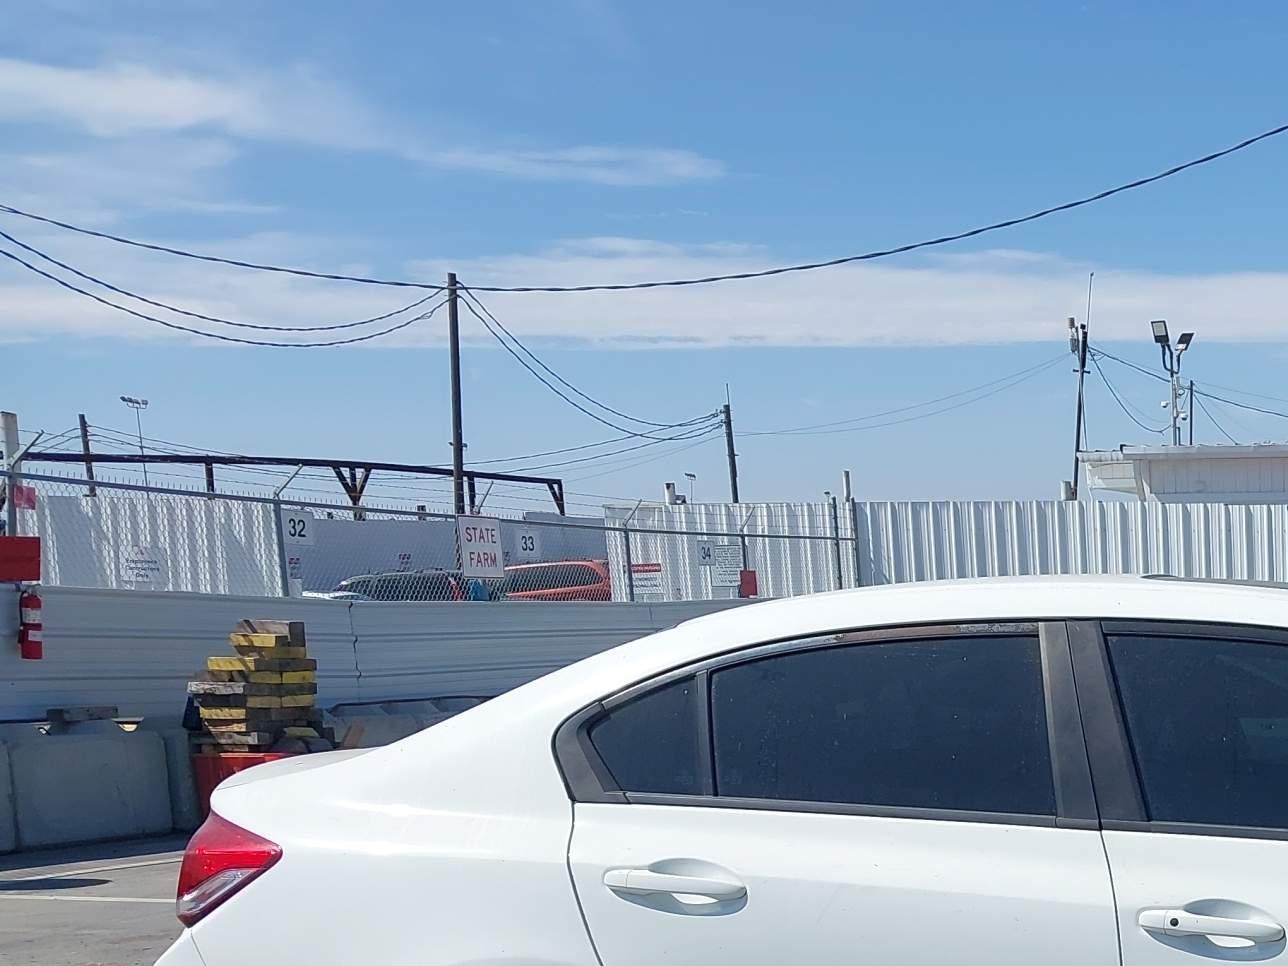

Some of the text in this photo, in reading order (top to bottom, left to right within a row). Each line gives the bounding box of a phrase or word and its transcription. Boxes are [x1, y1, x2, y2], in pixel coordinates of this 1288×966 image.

[288, 518, 307, 538] 32
[465, 526, 497, 544] STATE
[521, 535, 535, 552] 33
[469, 551, 498, 568] FARM
[701, 546, 712, 560] 34
